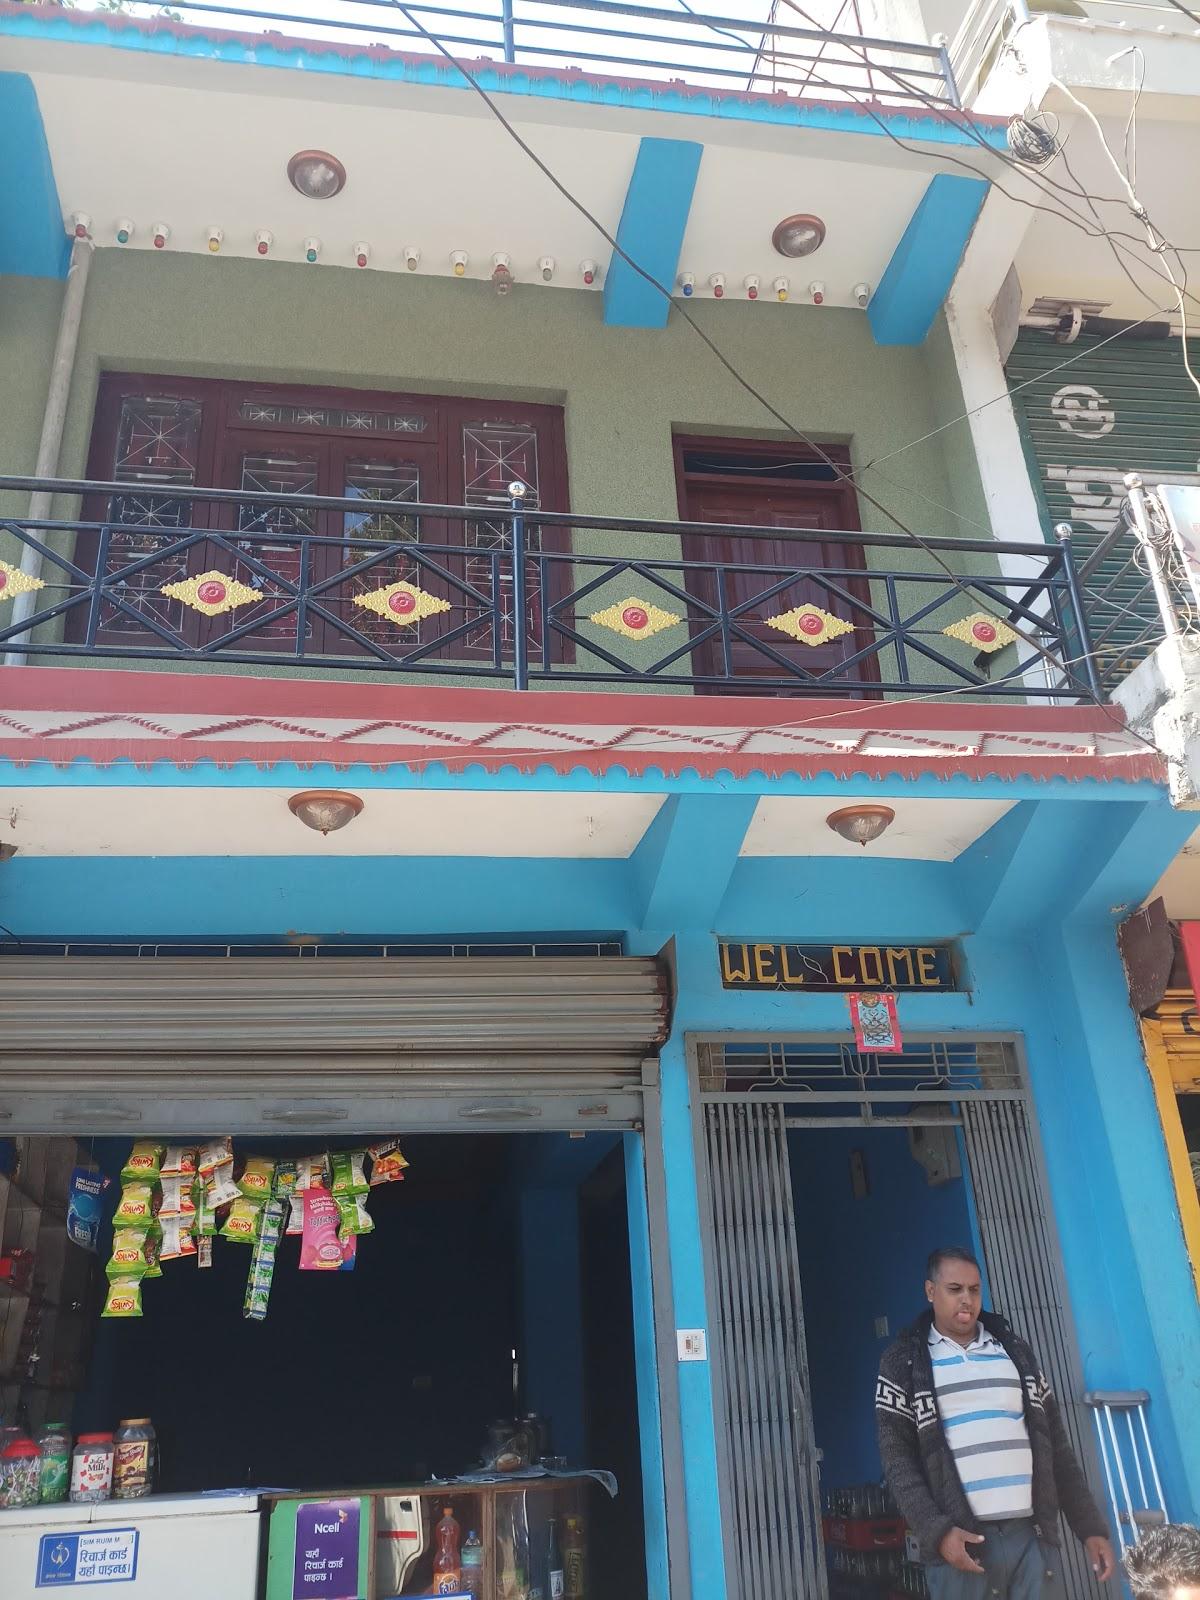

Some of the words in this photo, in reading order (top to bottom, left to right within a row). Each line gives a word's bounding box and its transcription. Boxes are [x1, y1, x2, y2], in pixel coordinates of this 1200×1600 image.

[723, 944, 804, 983] WEL
[832, 946, 940, 985] COME
[130, 1155, 154, 1168] Kwiks
[244, 1173, 267, 1188] Kwiks
[120, 1202, 146, 1215] Kwiks
[229, 1218, 253, 1233] Kwiks
[115, 1249, 139, 1262] Kwiks
[110, 1298, 135, 1311] Kwiks
[314, 1522, 340, 1534] Ncell
[80, 1548, 107, 1563] रिचार्ज
[109, 1547, 128, 1561] कार्ड
[304, 1558, 327, 1570] रिचार्ज
[328, 1557, 344, 1569] कार्ड
